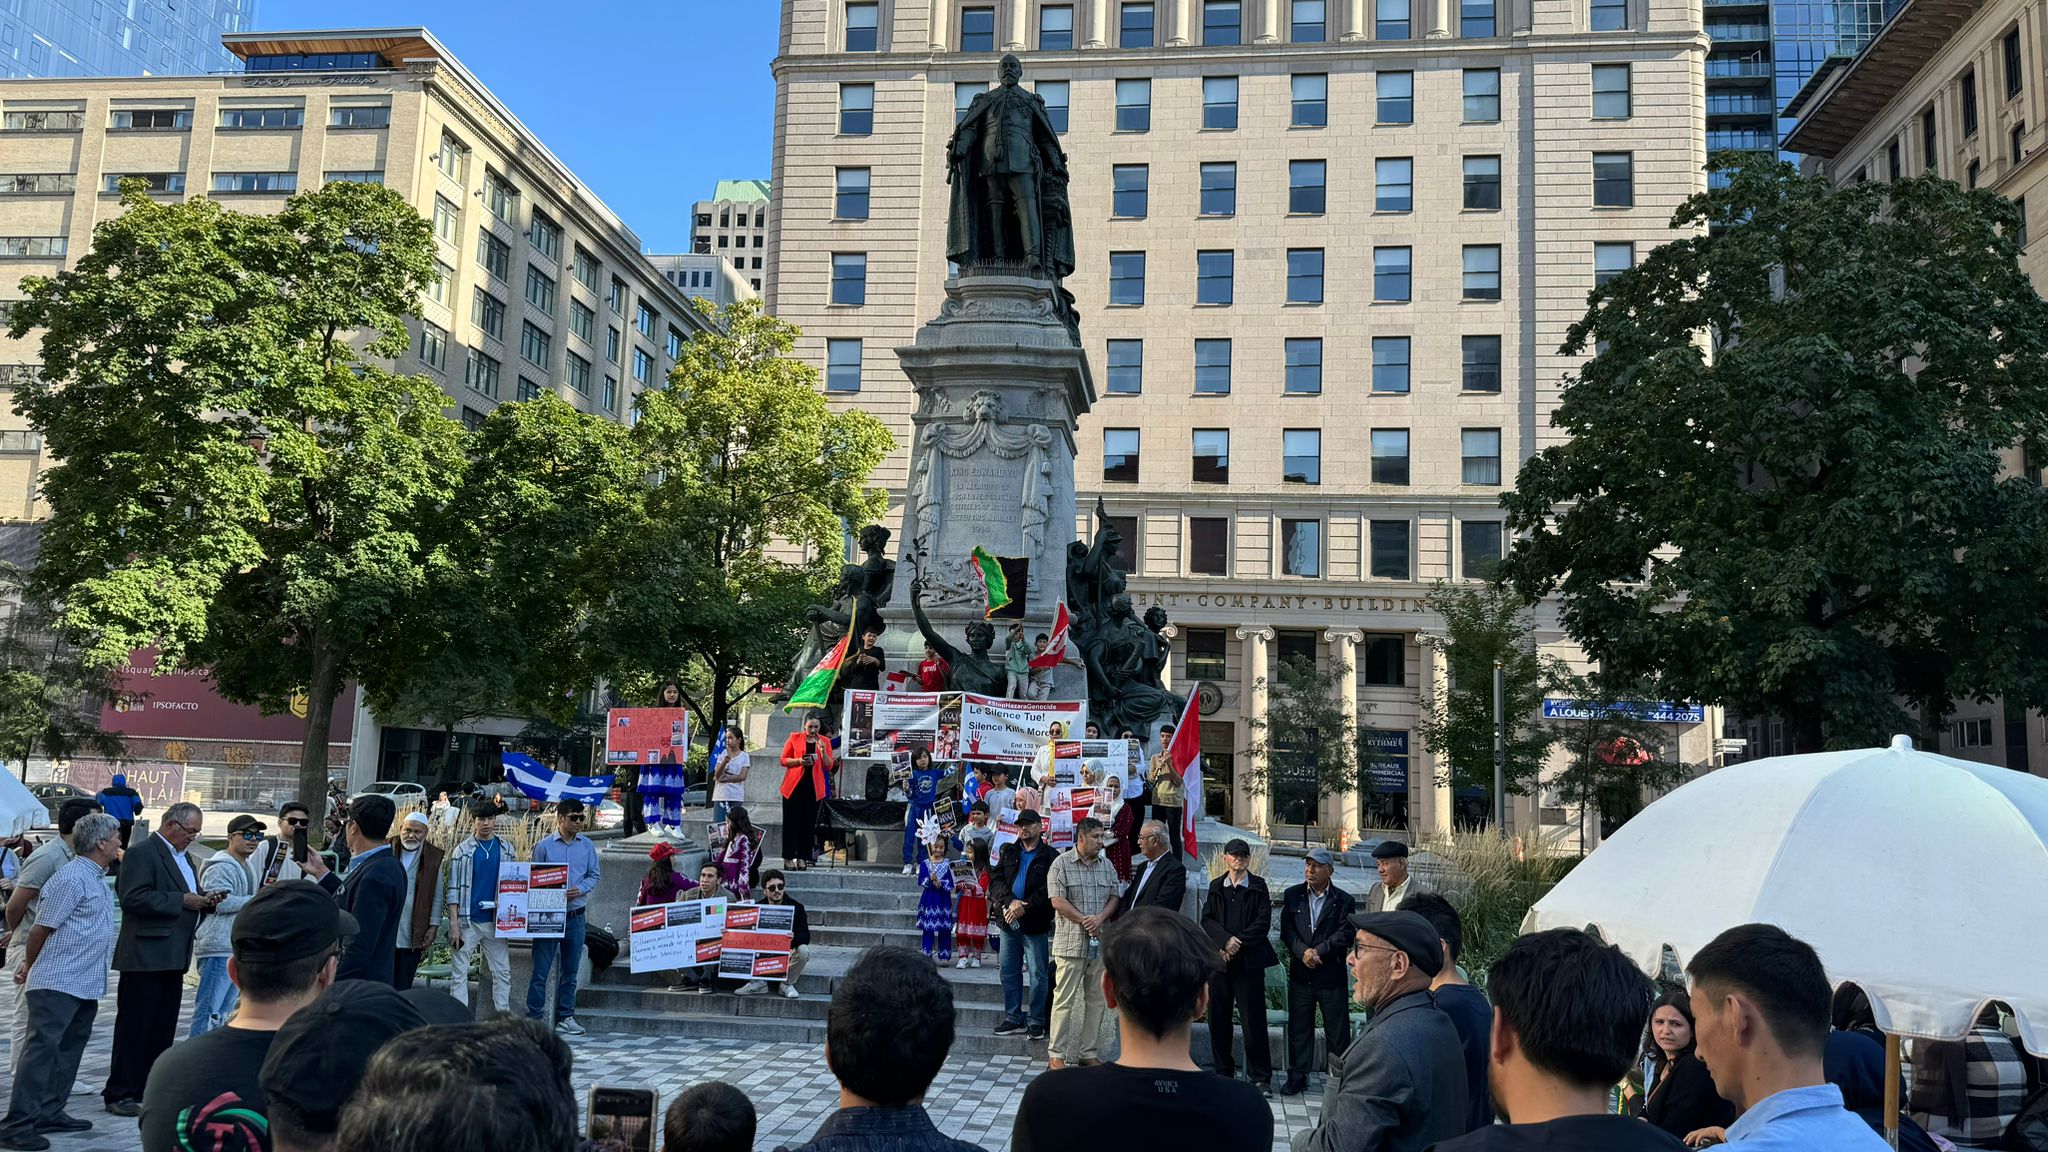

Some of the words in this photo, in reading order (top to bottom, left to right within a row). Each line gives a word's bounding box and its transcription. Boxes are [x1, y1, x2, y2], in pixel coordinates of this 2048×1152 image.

[1198, 594, 1308, 609] COMPANY
[152, 700, 199, 711] IPSOFACTO
[987, 700, 1057, 710] #StopHazaraGenocide
[969, 705, 982, 714] Le
[984, 707, 1021, 720] Silence
[1024, 712, 1046, 722] Tue!
[1560, 708, 1595, 718] LOUER
[1653, 712, 1674, 721] 444
[1675, 712, 1700, 722] 2075
[968, 721, 1003, 732] Silence
[1002, 748, 1033, 756] Massacres
[127, 770, 170, 784] HAUT
